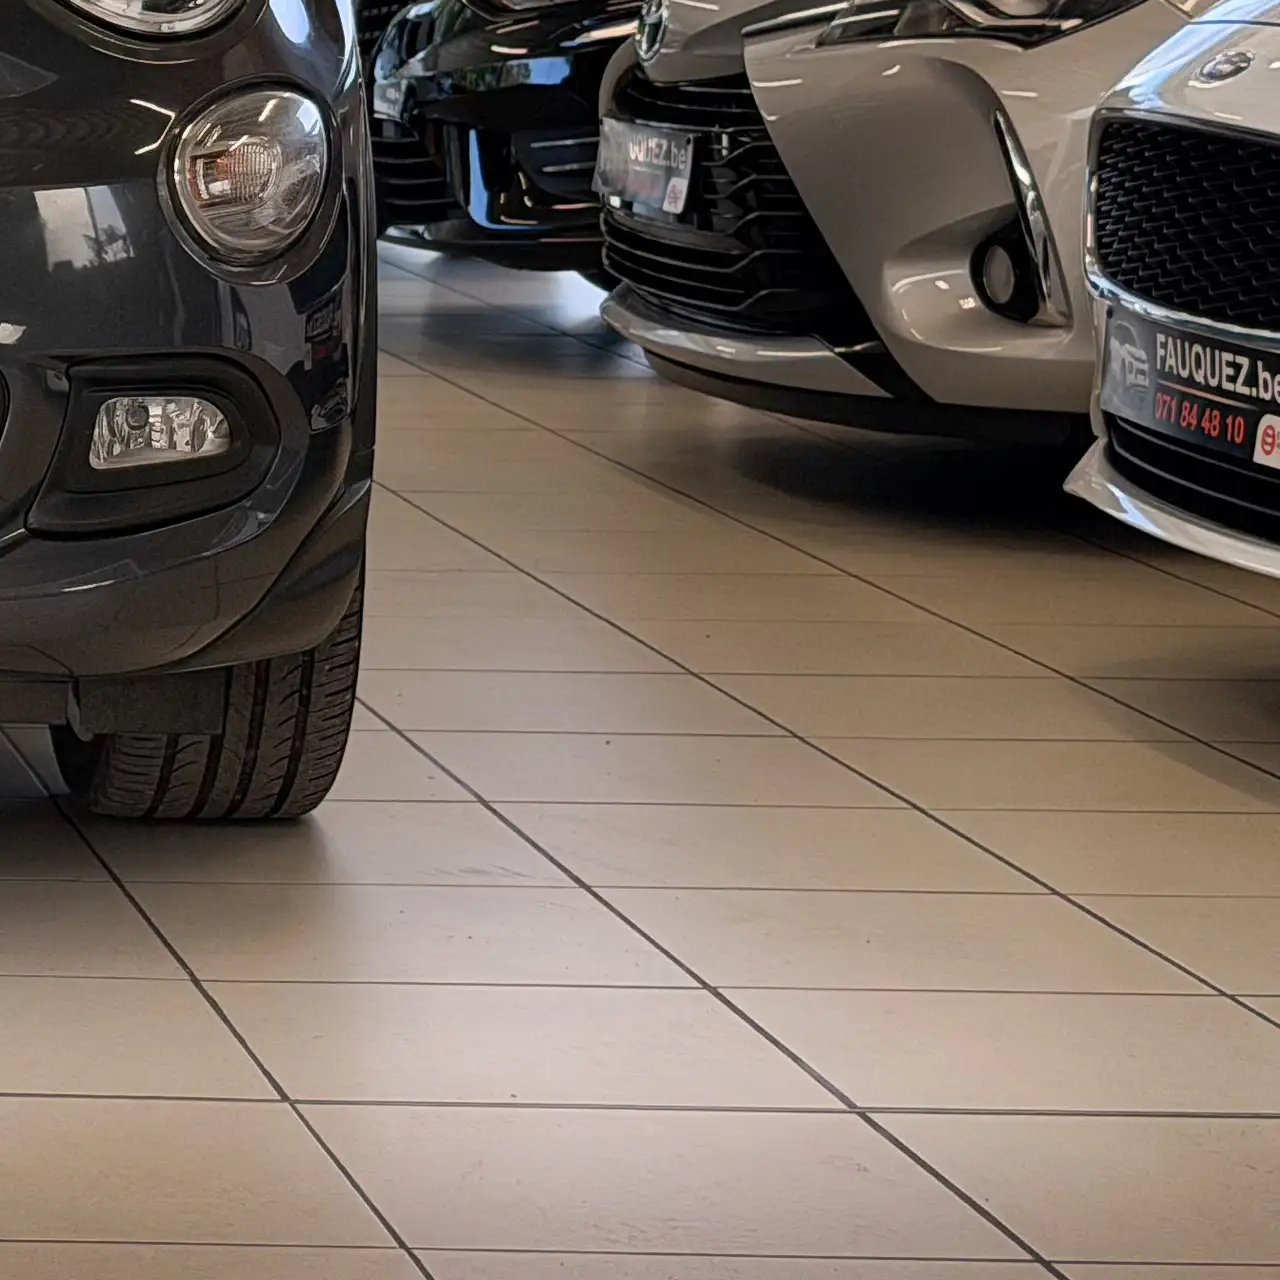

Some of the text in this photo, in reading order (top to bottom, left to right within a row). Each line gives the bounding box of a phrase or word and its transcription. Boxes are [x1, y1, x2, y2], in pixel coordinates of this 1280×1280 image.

[1154, 392, 1176, 424] 071
[1180, 399, 1198, 431] 84
[1201, 407, 1220, 438] 48
[1226, 414, 1245, 445] 10
